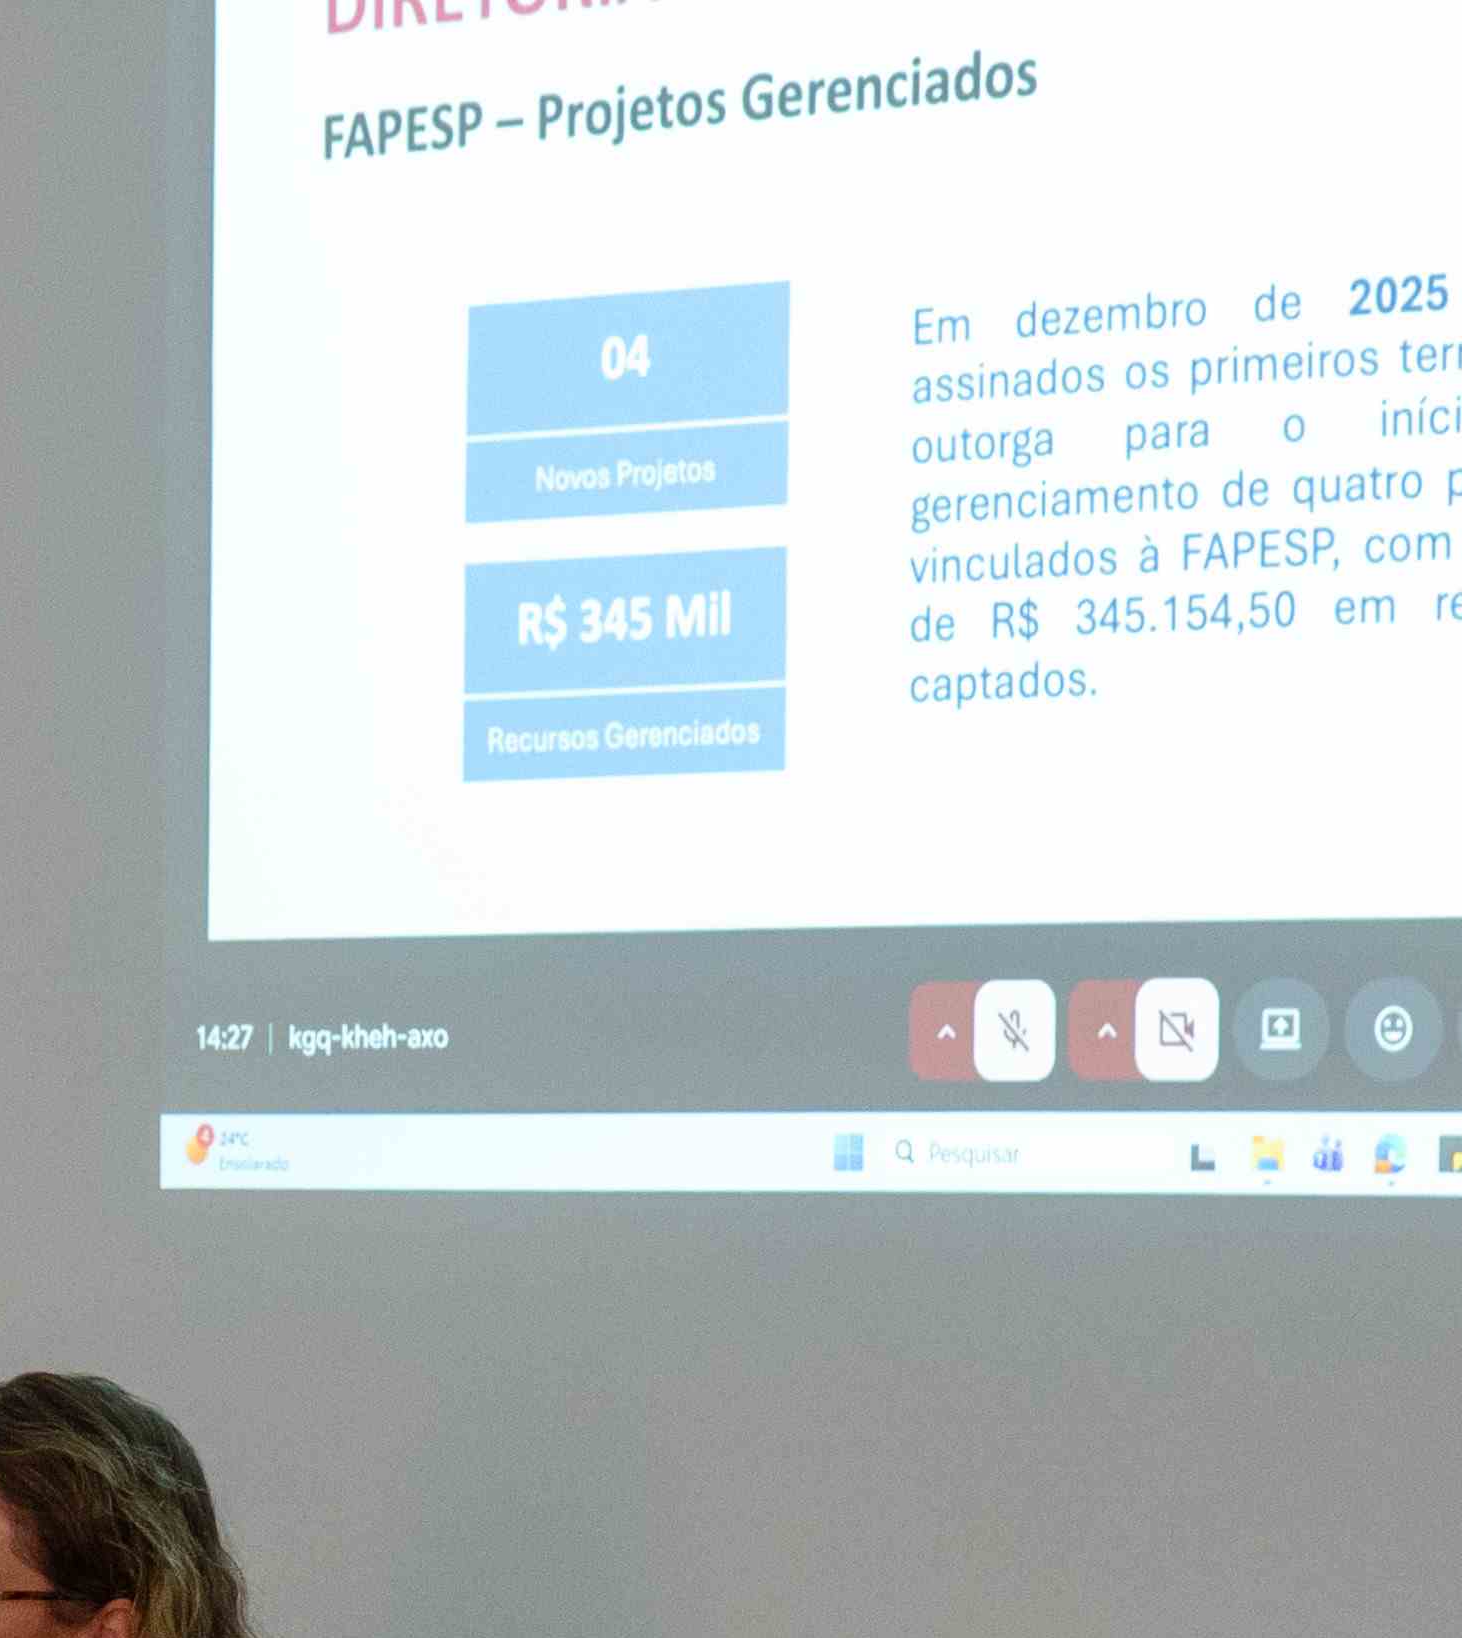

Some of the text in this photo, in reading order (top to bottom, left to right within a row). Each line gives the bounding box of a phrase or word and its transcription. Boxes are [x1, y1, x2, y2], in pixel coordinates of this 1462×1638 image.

[324, 101, 483, 161] FAPESP
[538, 84, 727, 147] Projetos
[741, 49, 1037, 121] Gerenciados
[913, 307, 971, 346] Em
[1016, 292, 1207, 339] dezembro
[1253, 283, 1302, 323] de
[1349, 273, 1449, 316] 2025
[600, 334, 651, 382] 04
[912, 358, 1105, 405] assinados
[1125, 359, 1170, 390] os
[1190, 341, 1379, 396] primeiros
[912, 426, 1054, 469] outorga
[1125, 419, 1210, 461] para
[1282, 413, 1306, 443] o
[534, 458, 717, 492] Novos Projetos
[911, 478, 1201, 535] gerenciamento
[1221, 469, 1269, 509] de
[1293, 467, 1423, 508] quatro
[910, 541, 1118, 585] vinculados
[1139, 535, 1159, 574] à
[1182, 527, 1340, 571] FAPESP,
[1365, 531, 1452, 564] com
[517, 589, 732, 651] R$ 345 Mil
[910, 606, 955, 643] de
[992, 599, 1039, 641] R$
[1076, 590, 1296, 636] 345.154,50
[1333, 594, 1396, 625] em
[910, 661, 1097, 711] captados.
[486, 719, 761, 754] Recursos Gerenciados
[196, 1022, 450, 1057] 14:27 kgq-kheh-axo
[928, 1140, 1019, 1169] Pesquisar
